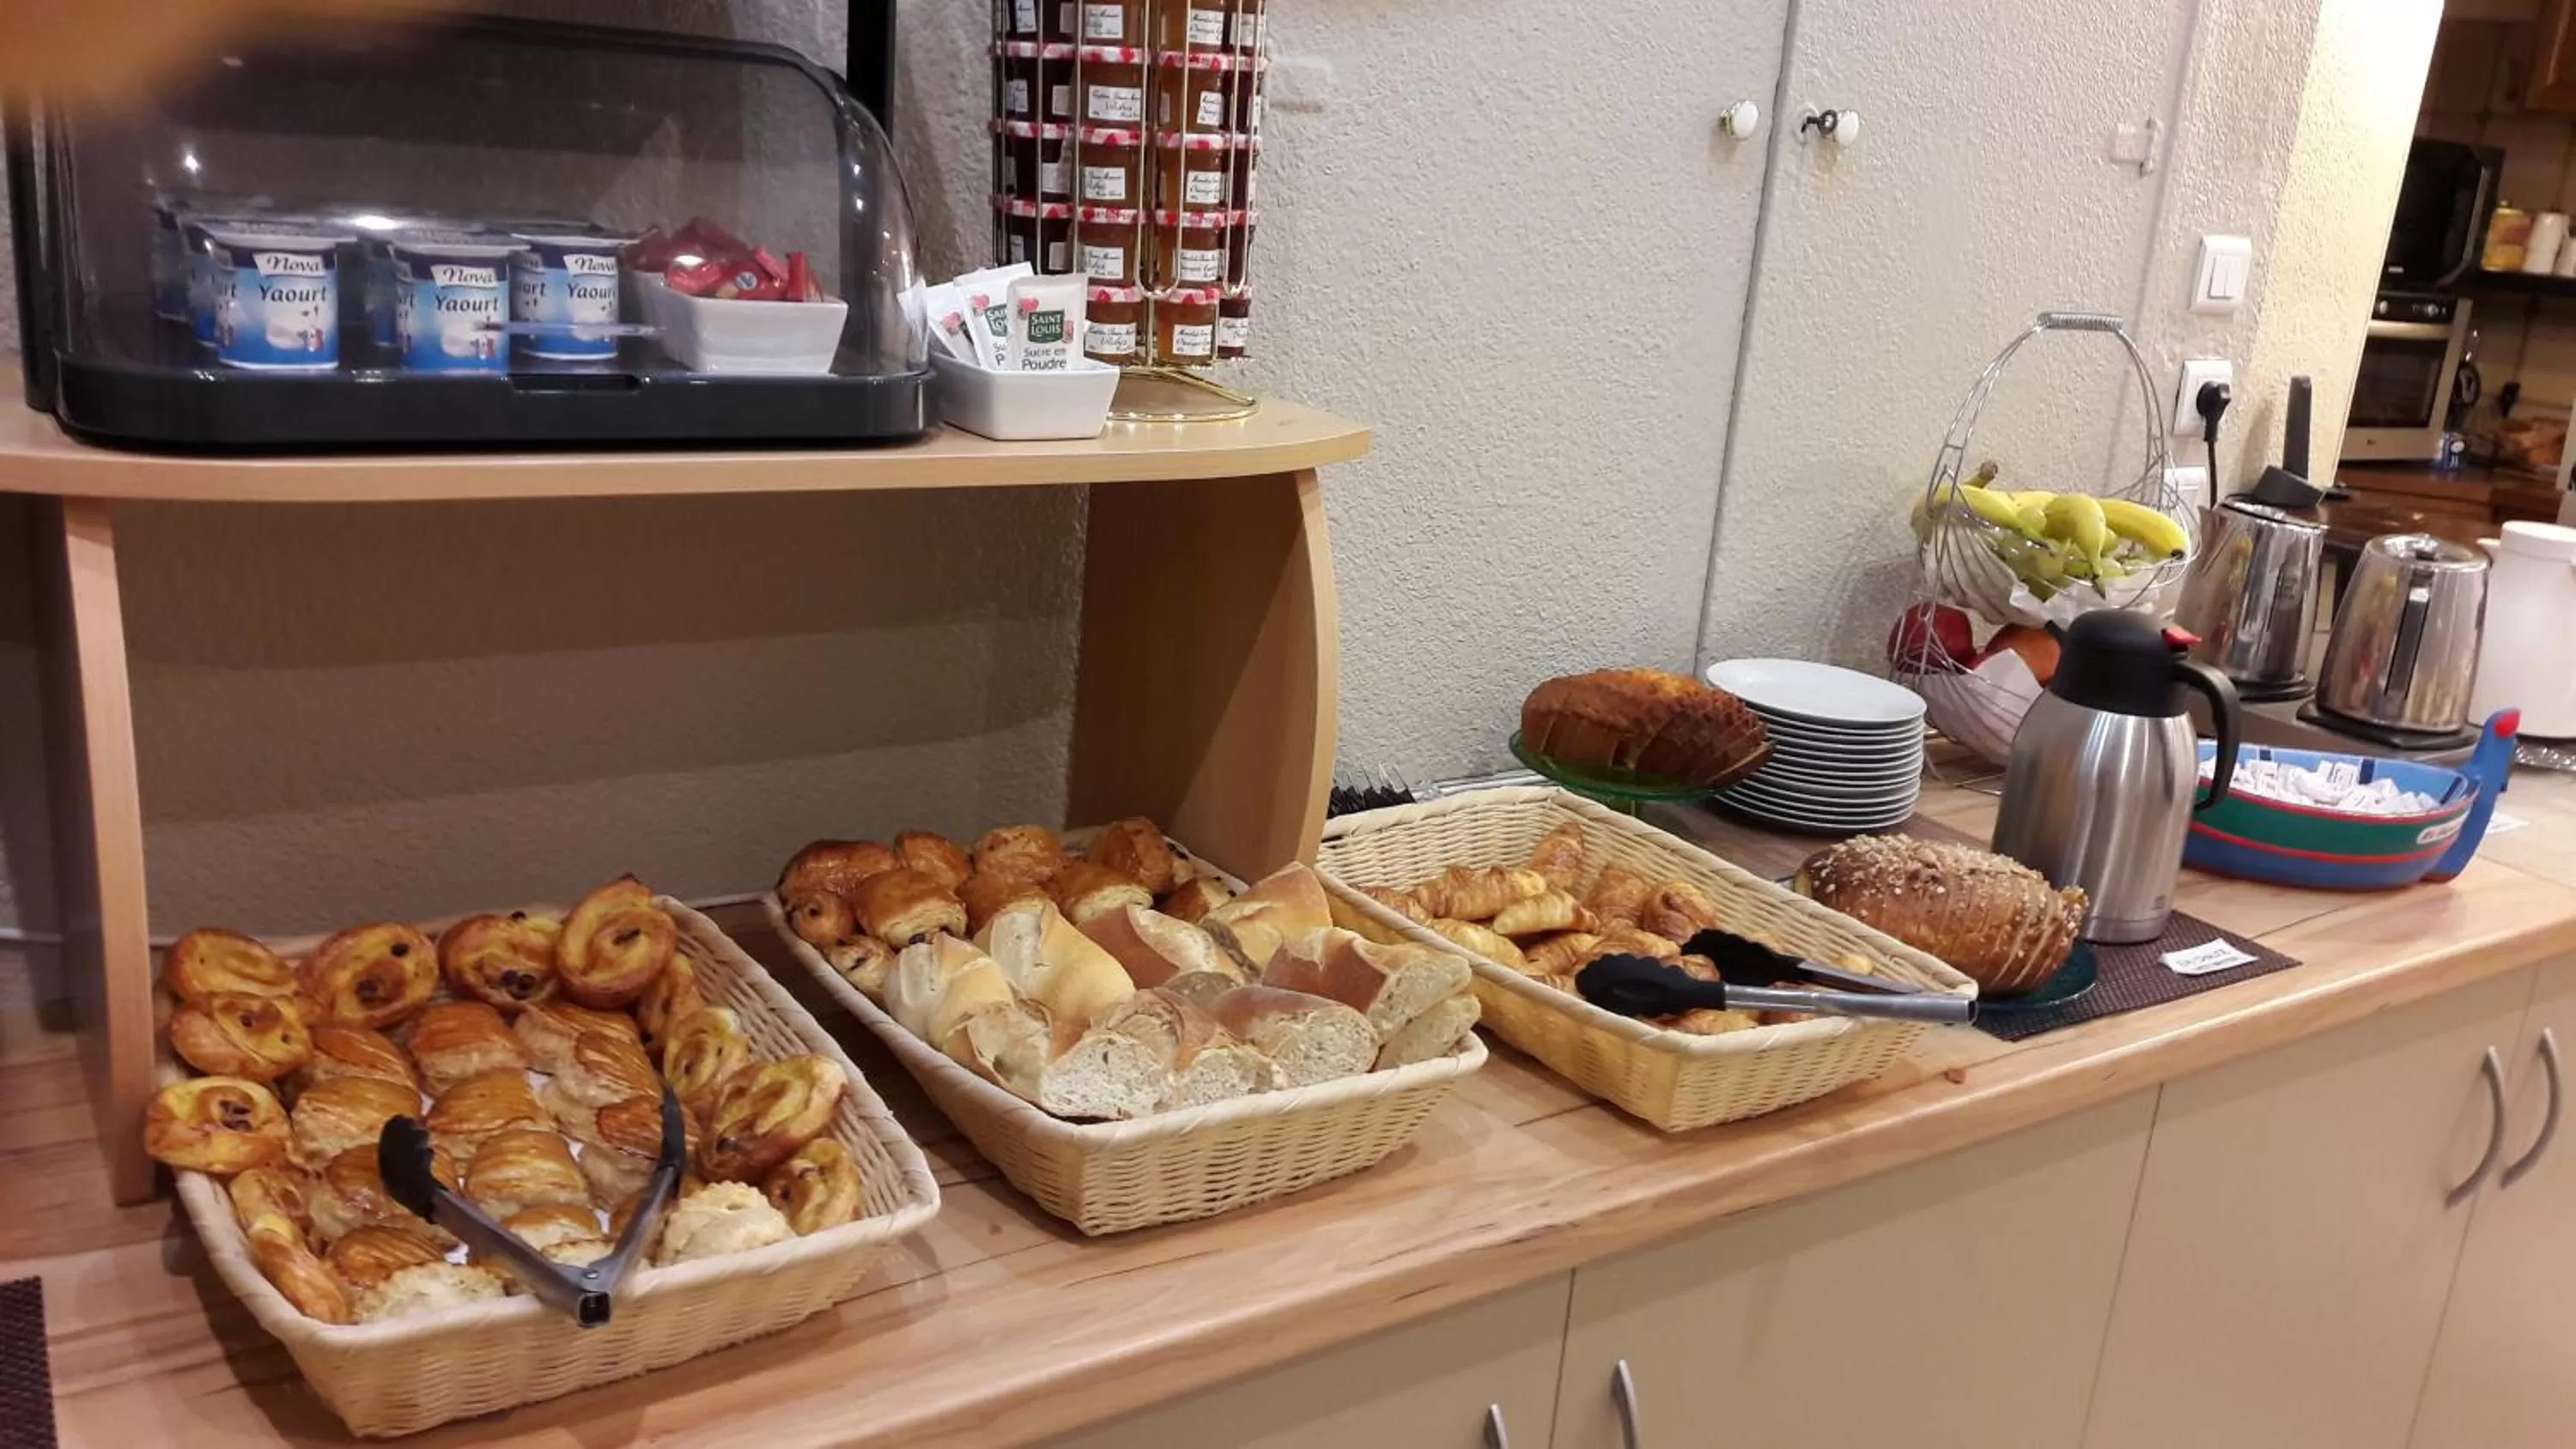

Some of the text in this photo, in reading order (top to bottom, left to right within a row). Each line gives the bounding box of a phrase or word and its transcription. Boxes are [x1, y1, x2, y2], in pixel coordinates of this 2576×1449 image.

[265, 256, 319, 271] Nova
[442, 267, 494, 283] Nova
[258, 283, 327, 302] Yaourt
[434, 294, 498, 312] Yaourt
[1030, 313, 1063, 325] SAINT
[1030, 324, 1062, 336] LOUIS
[1023, 347, 1052, 358] Sucre
[1021, 358, 1067, 371] Poudre
